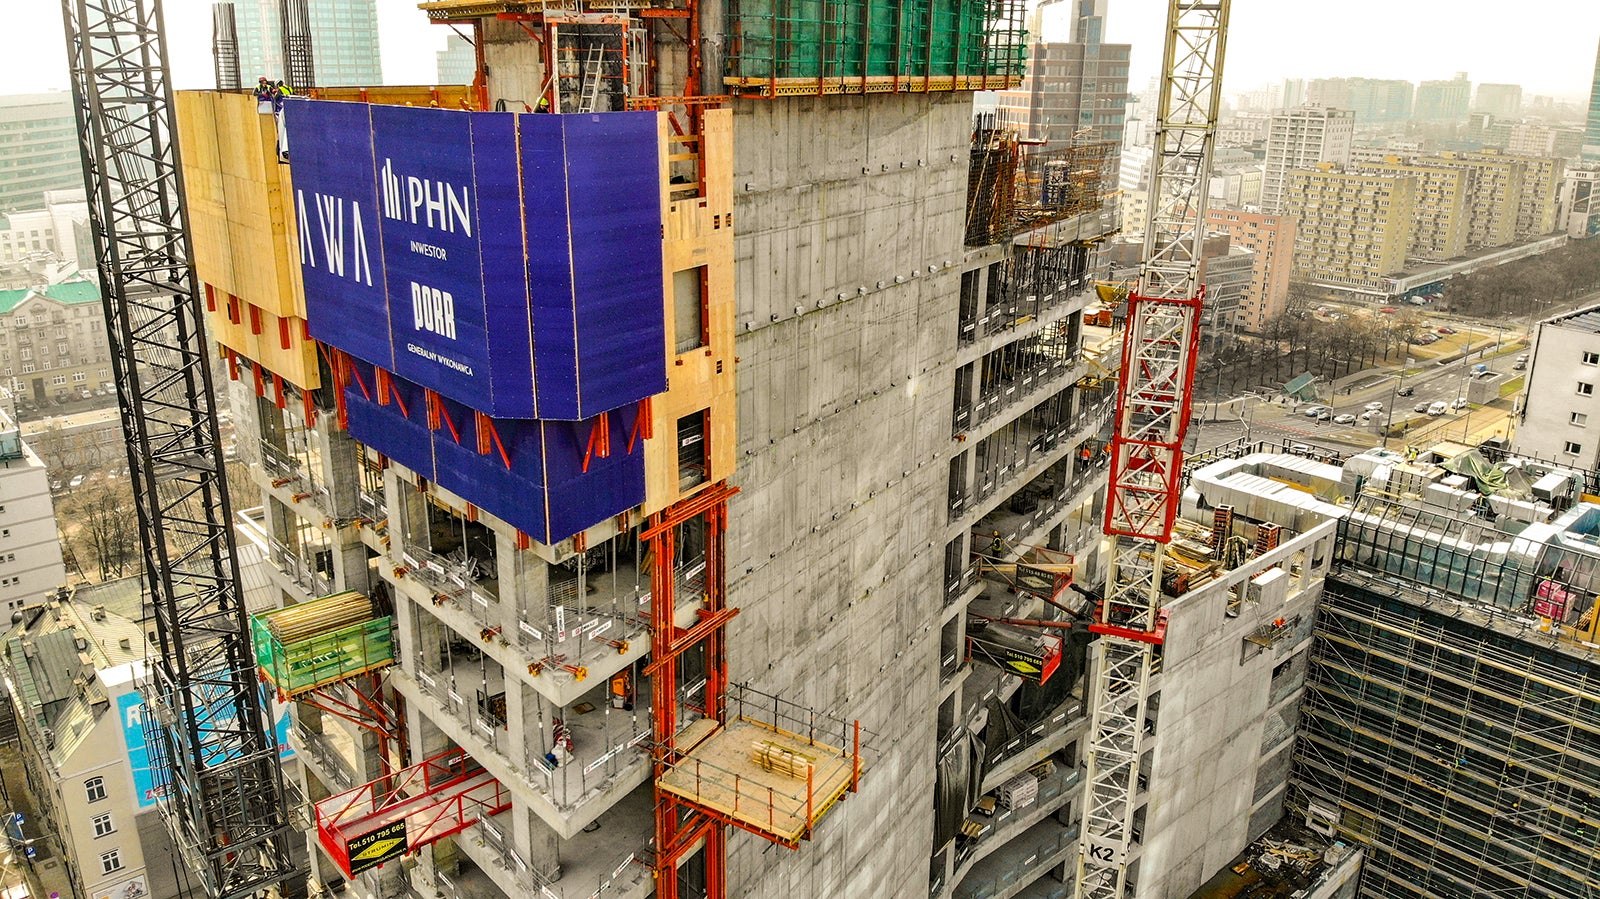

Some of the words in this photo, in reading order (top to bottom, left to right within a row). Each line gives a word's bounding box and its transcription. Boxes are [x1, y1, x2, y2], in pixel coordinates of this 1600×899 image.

[408, 176, 472, 238] PHN
[410, 240, 448, 261] INWESTOR
[411, 281, 457, 341] PORR
[407, 343, 437, 362] GENERALNY
[437, 354, 474, 377] WYKONAWCA
[377, 828, 390, 838] 795
[392, 822, 404, 832] 665
[1090, 843, 1115, 863] K2
